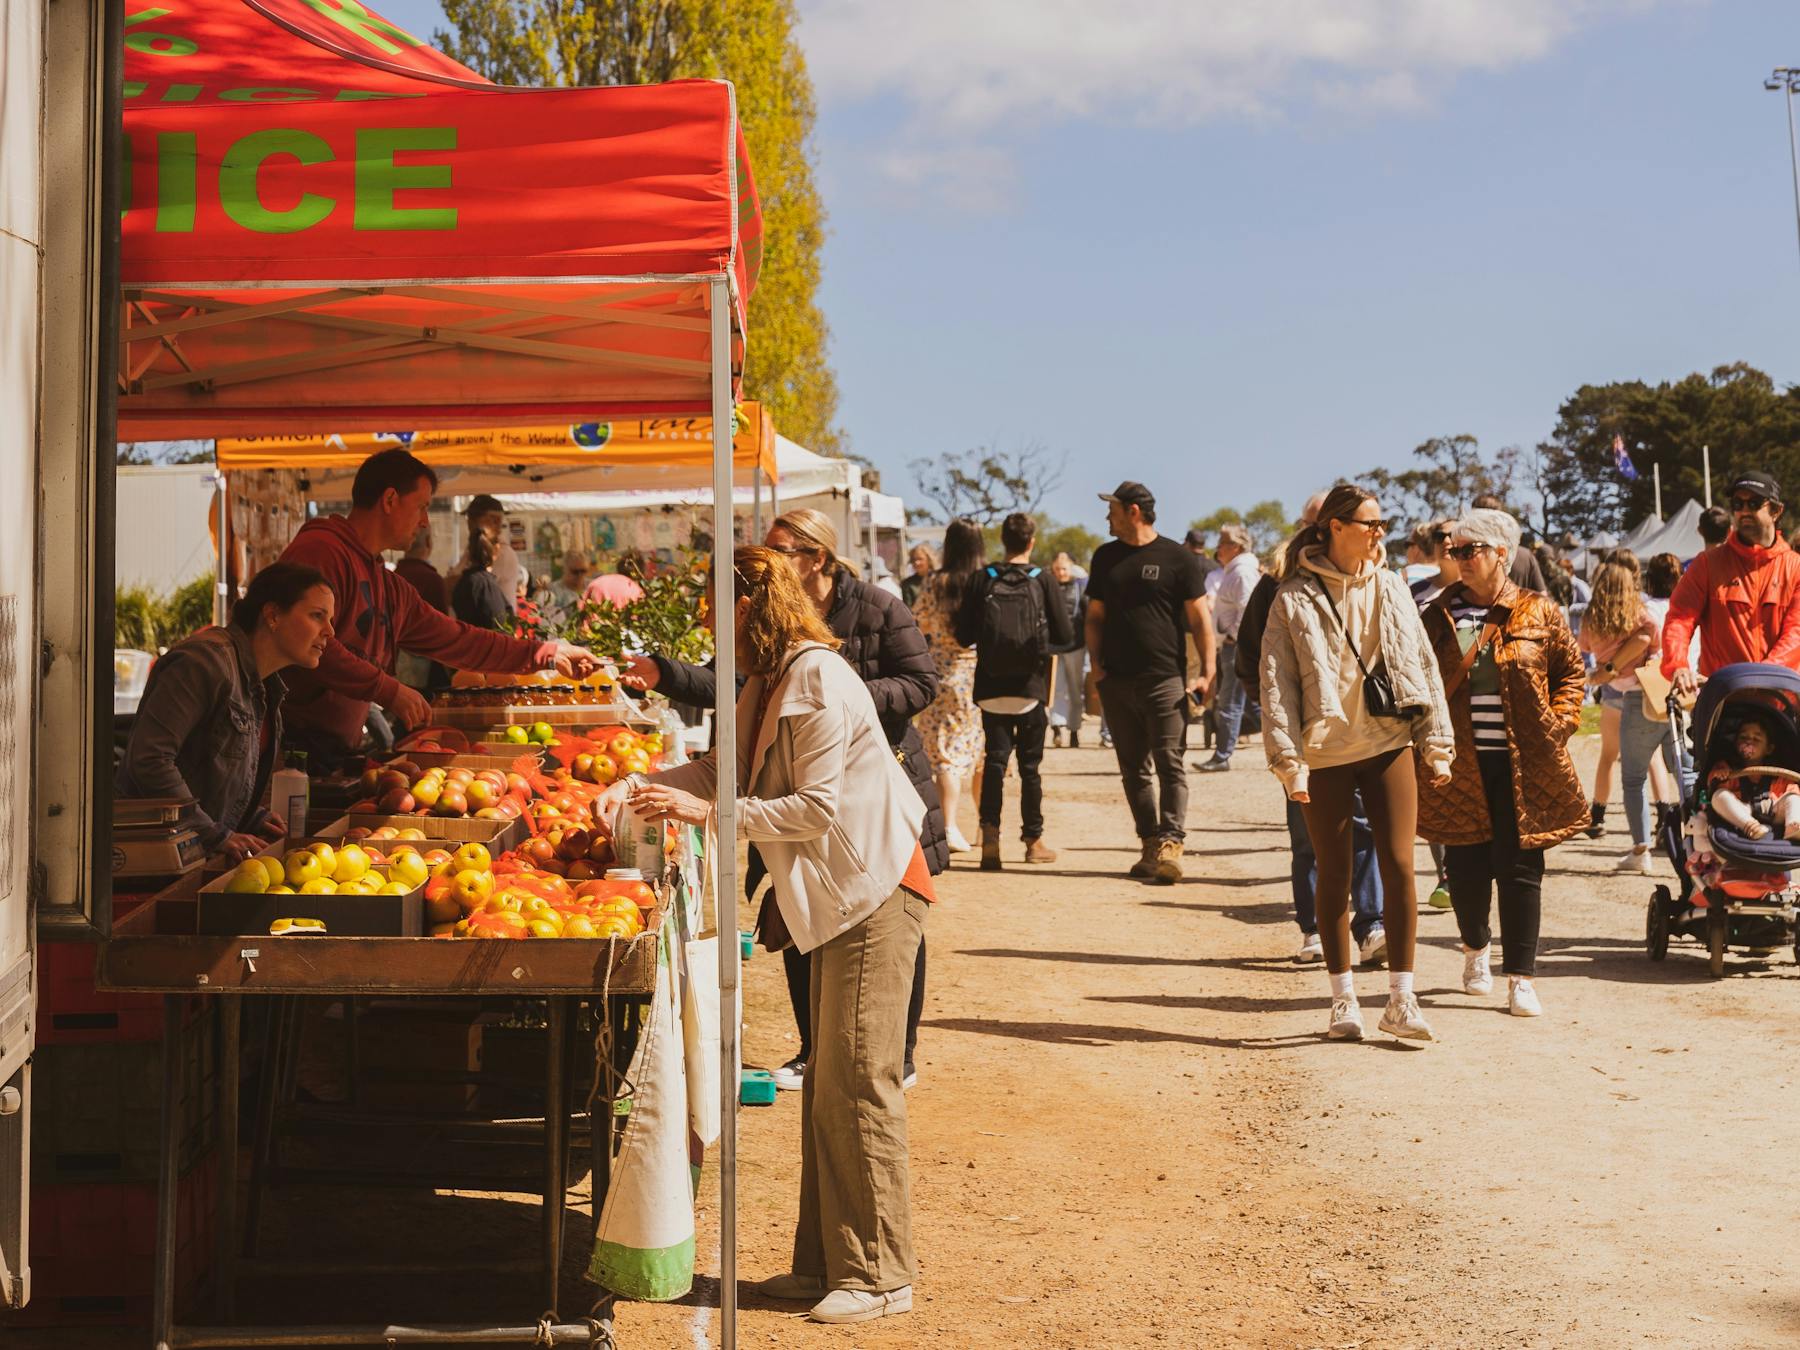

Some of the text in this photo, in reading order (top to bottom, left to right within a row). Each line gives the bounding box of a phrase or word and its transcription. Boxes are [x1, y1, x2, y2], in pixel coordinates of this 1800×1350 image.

[121, 127, 458, 234] ICE
[422, 431, 568, 447] Sold around the World
